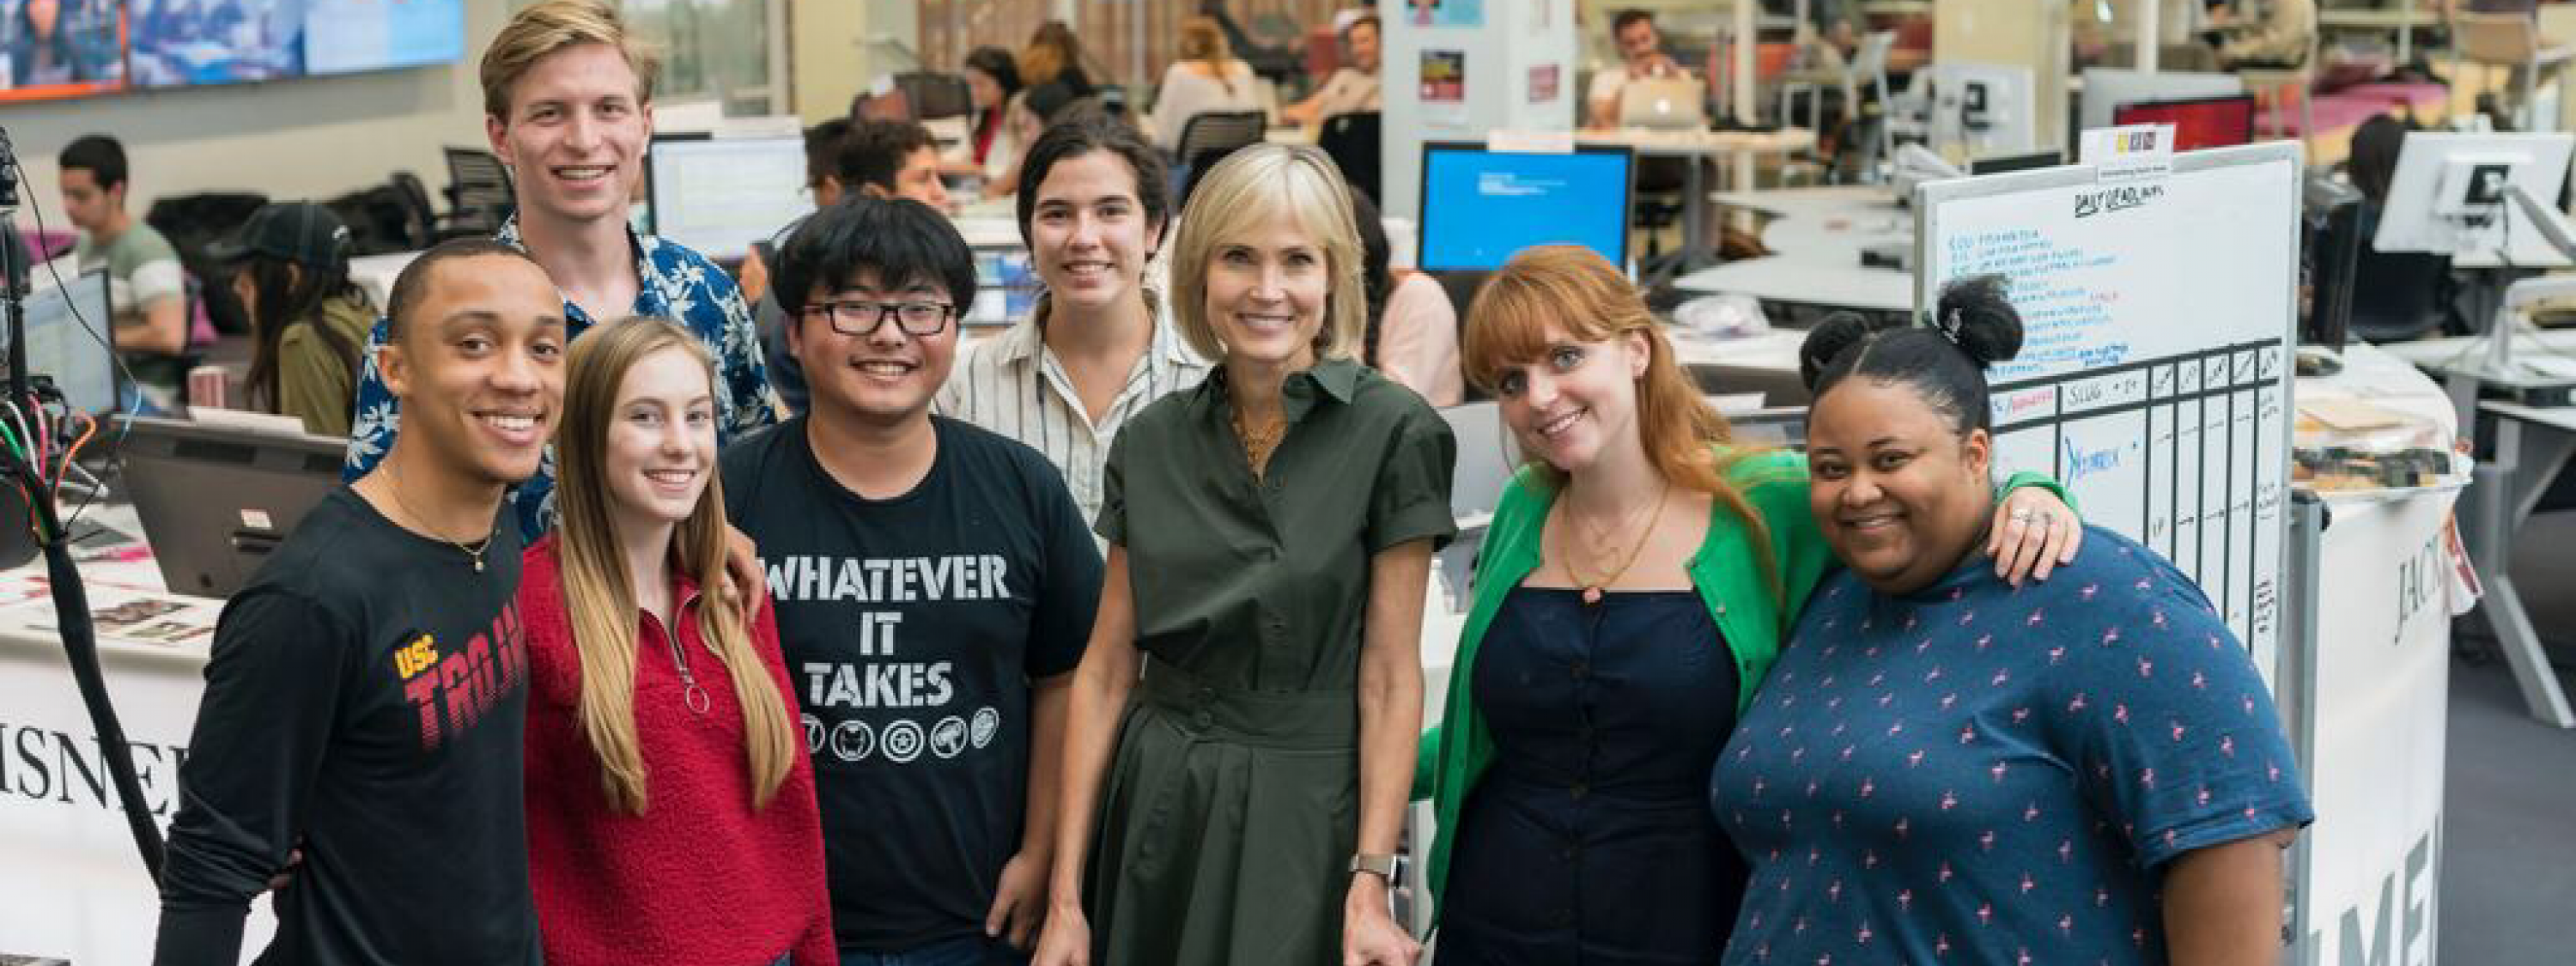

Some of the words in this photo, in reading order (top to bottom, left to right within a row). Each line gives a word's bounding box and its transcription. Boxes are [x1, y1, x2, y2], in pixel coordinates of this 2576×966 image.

[756, 555, 1010, 601] WHATEVER
[860, 611, 902, 655] IT
[394, 634, 438, 678] USC
[804, 661, 953, 707] TAKES
